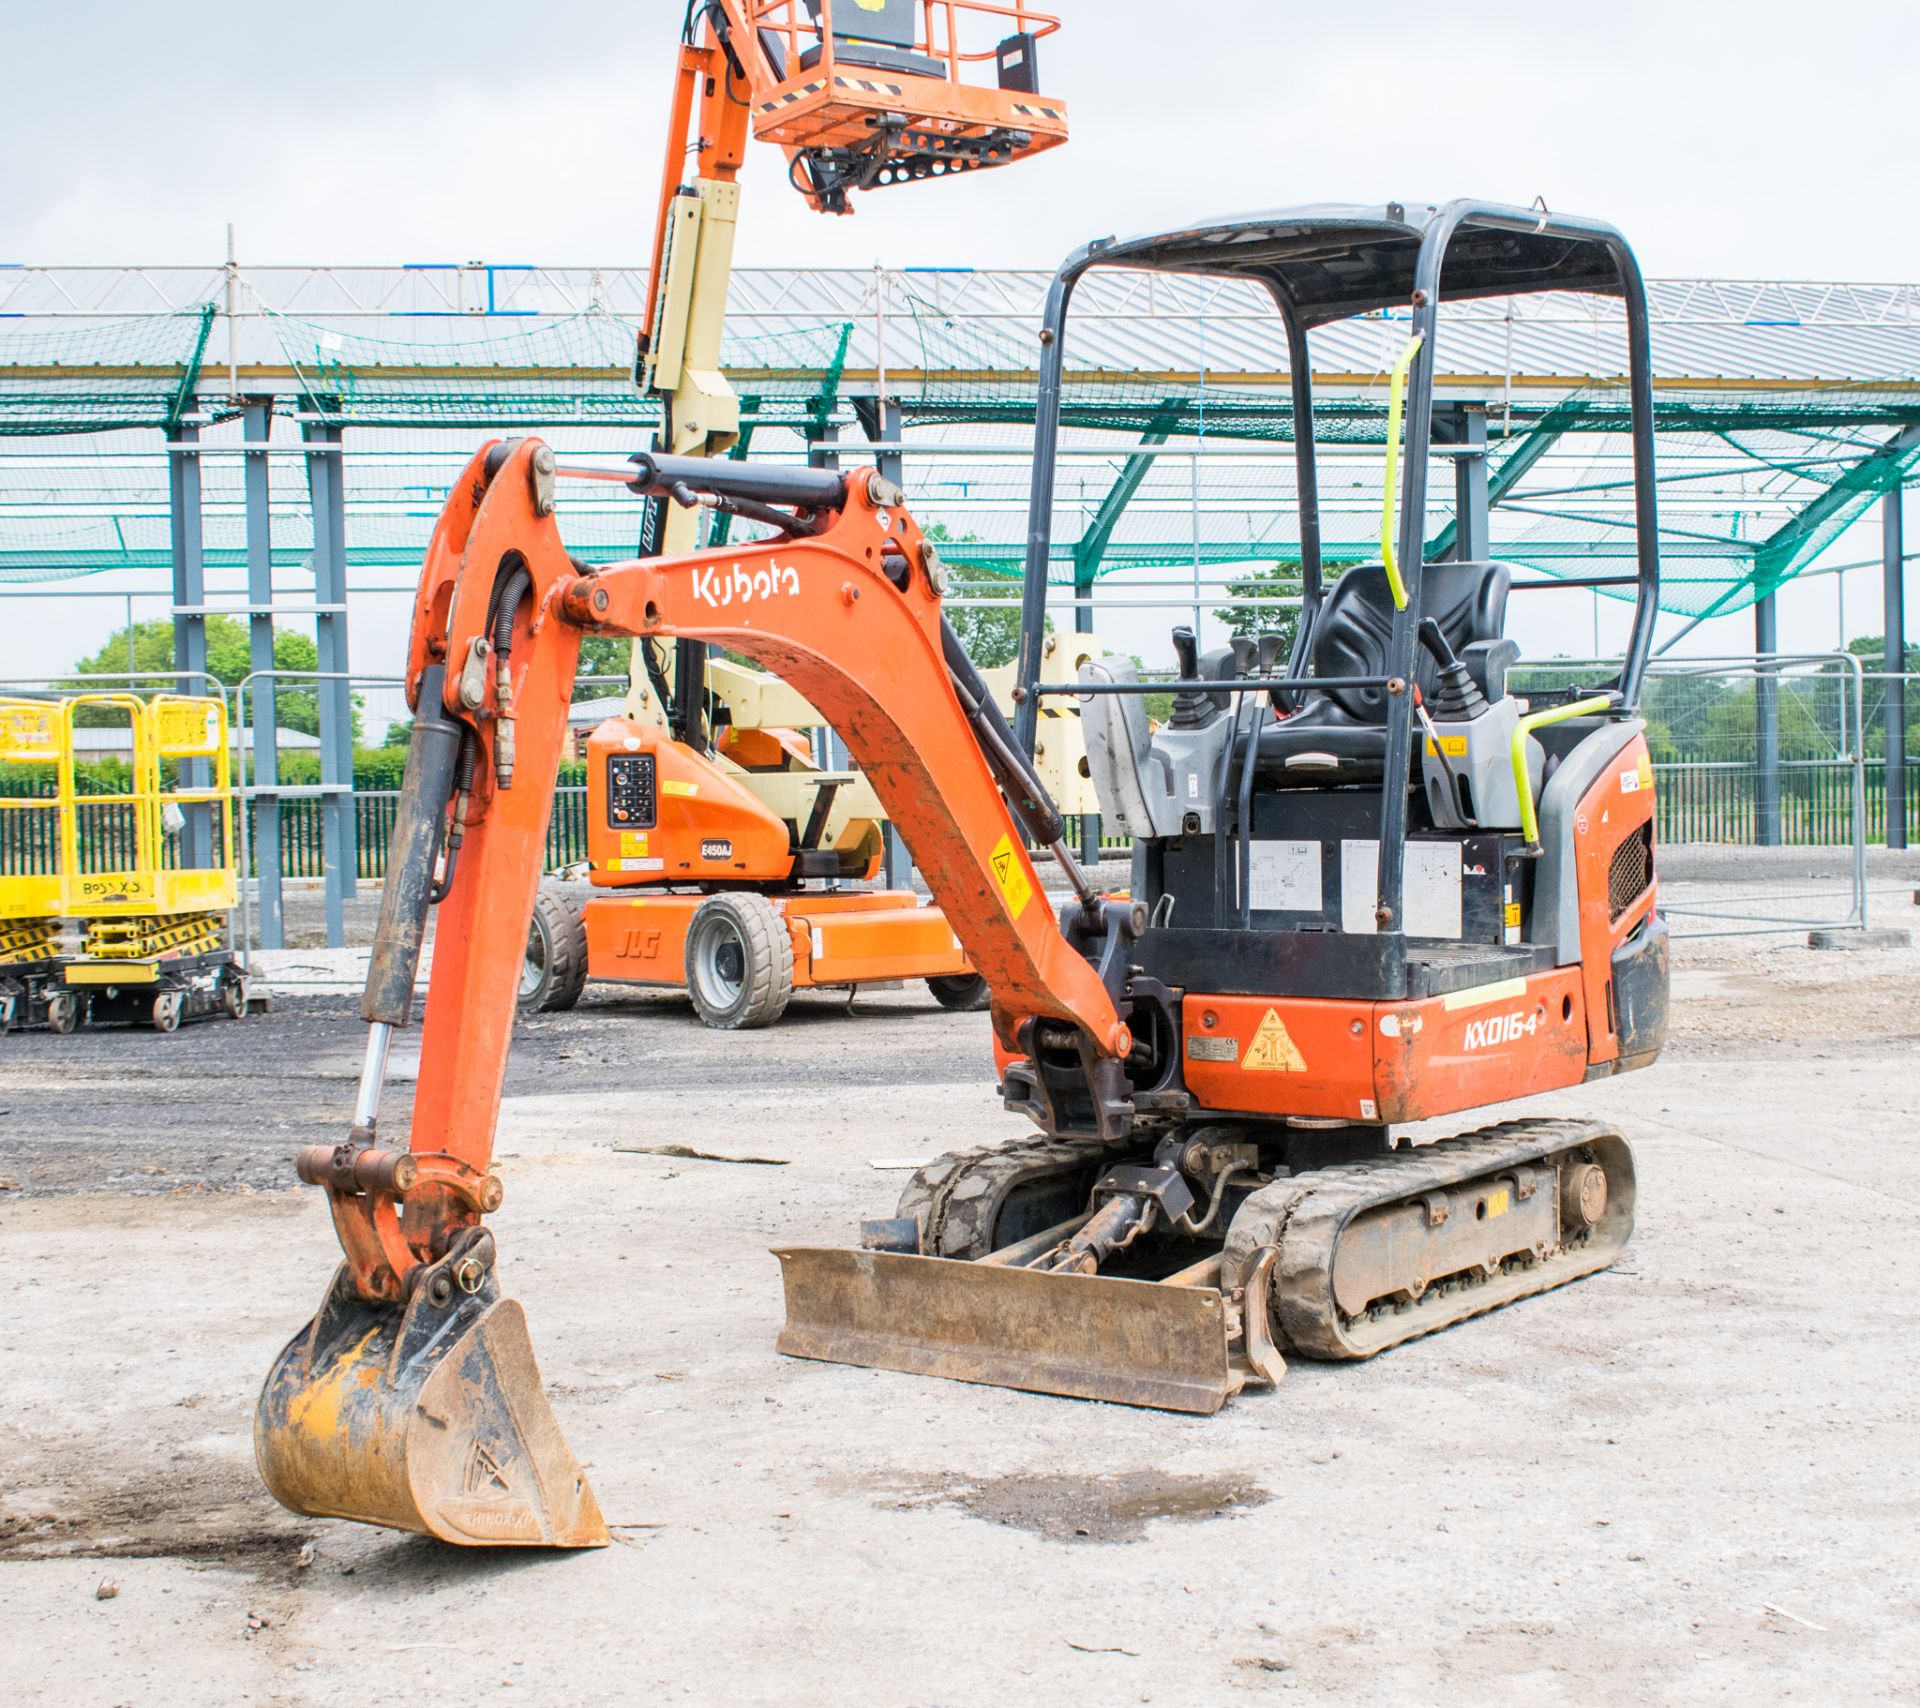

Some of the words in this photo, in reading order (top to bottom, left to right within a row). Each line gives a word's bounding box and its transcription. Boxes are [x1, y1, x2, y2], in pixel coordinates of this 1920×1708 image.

[692, 558, 800, 608] Kubota
[702, 844, 733, 856] E450AJ
[616, 929, 662, 959] JLG
[1463, 1011, 1537, 1051] KX016-4
